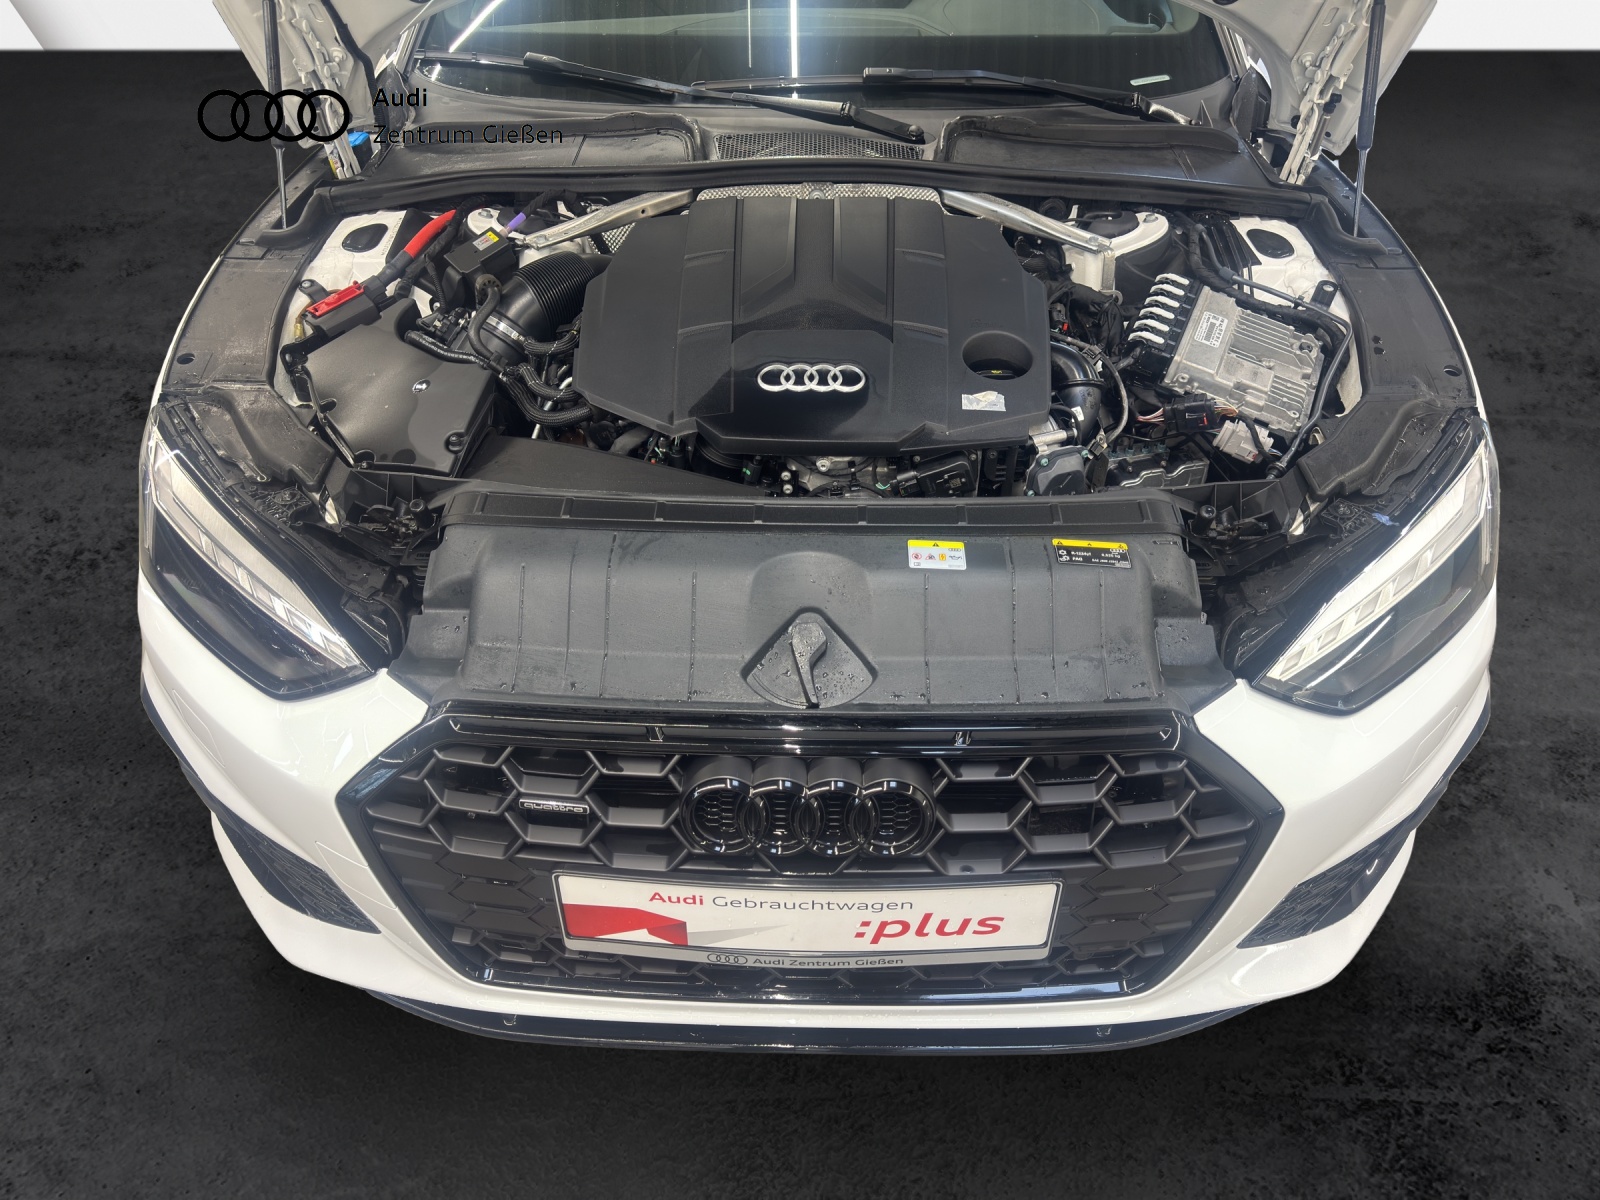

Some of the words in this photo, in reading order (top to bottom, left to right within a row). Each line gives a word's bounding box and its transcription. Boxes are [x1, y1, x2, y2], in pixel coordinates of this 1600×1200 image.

[524, 803, 583, 812] quattro
[648, 891, 704, 906] Audi
[711, 895, 914, 914] Gebrauchtwagen
[752, 957, 786, 966] Audi
[789, 957, 852, 967] Zentrum
[855, 957, 904, 966] Gießen
